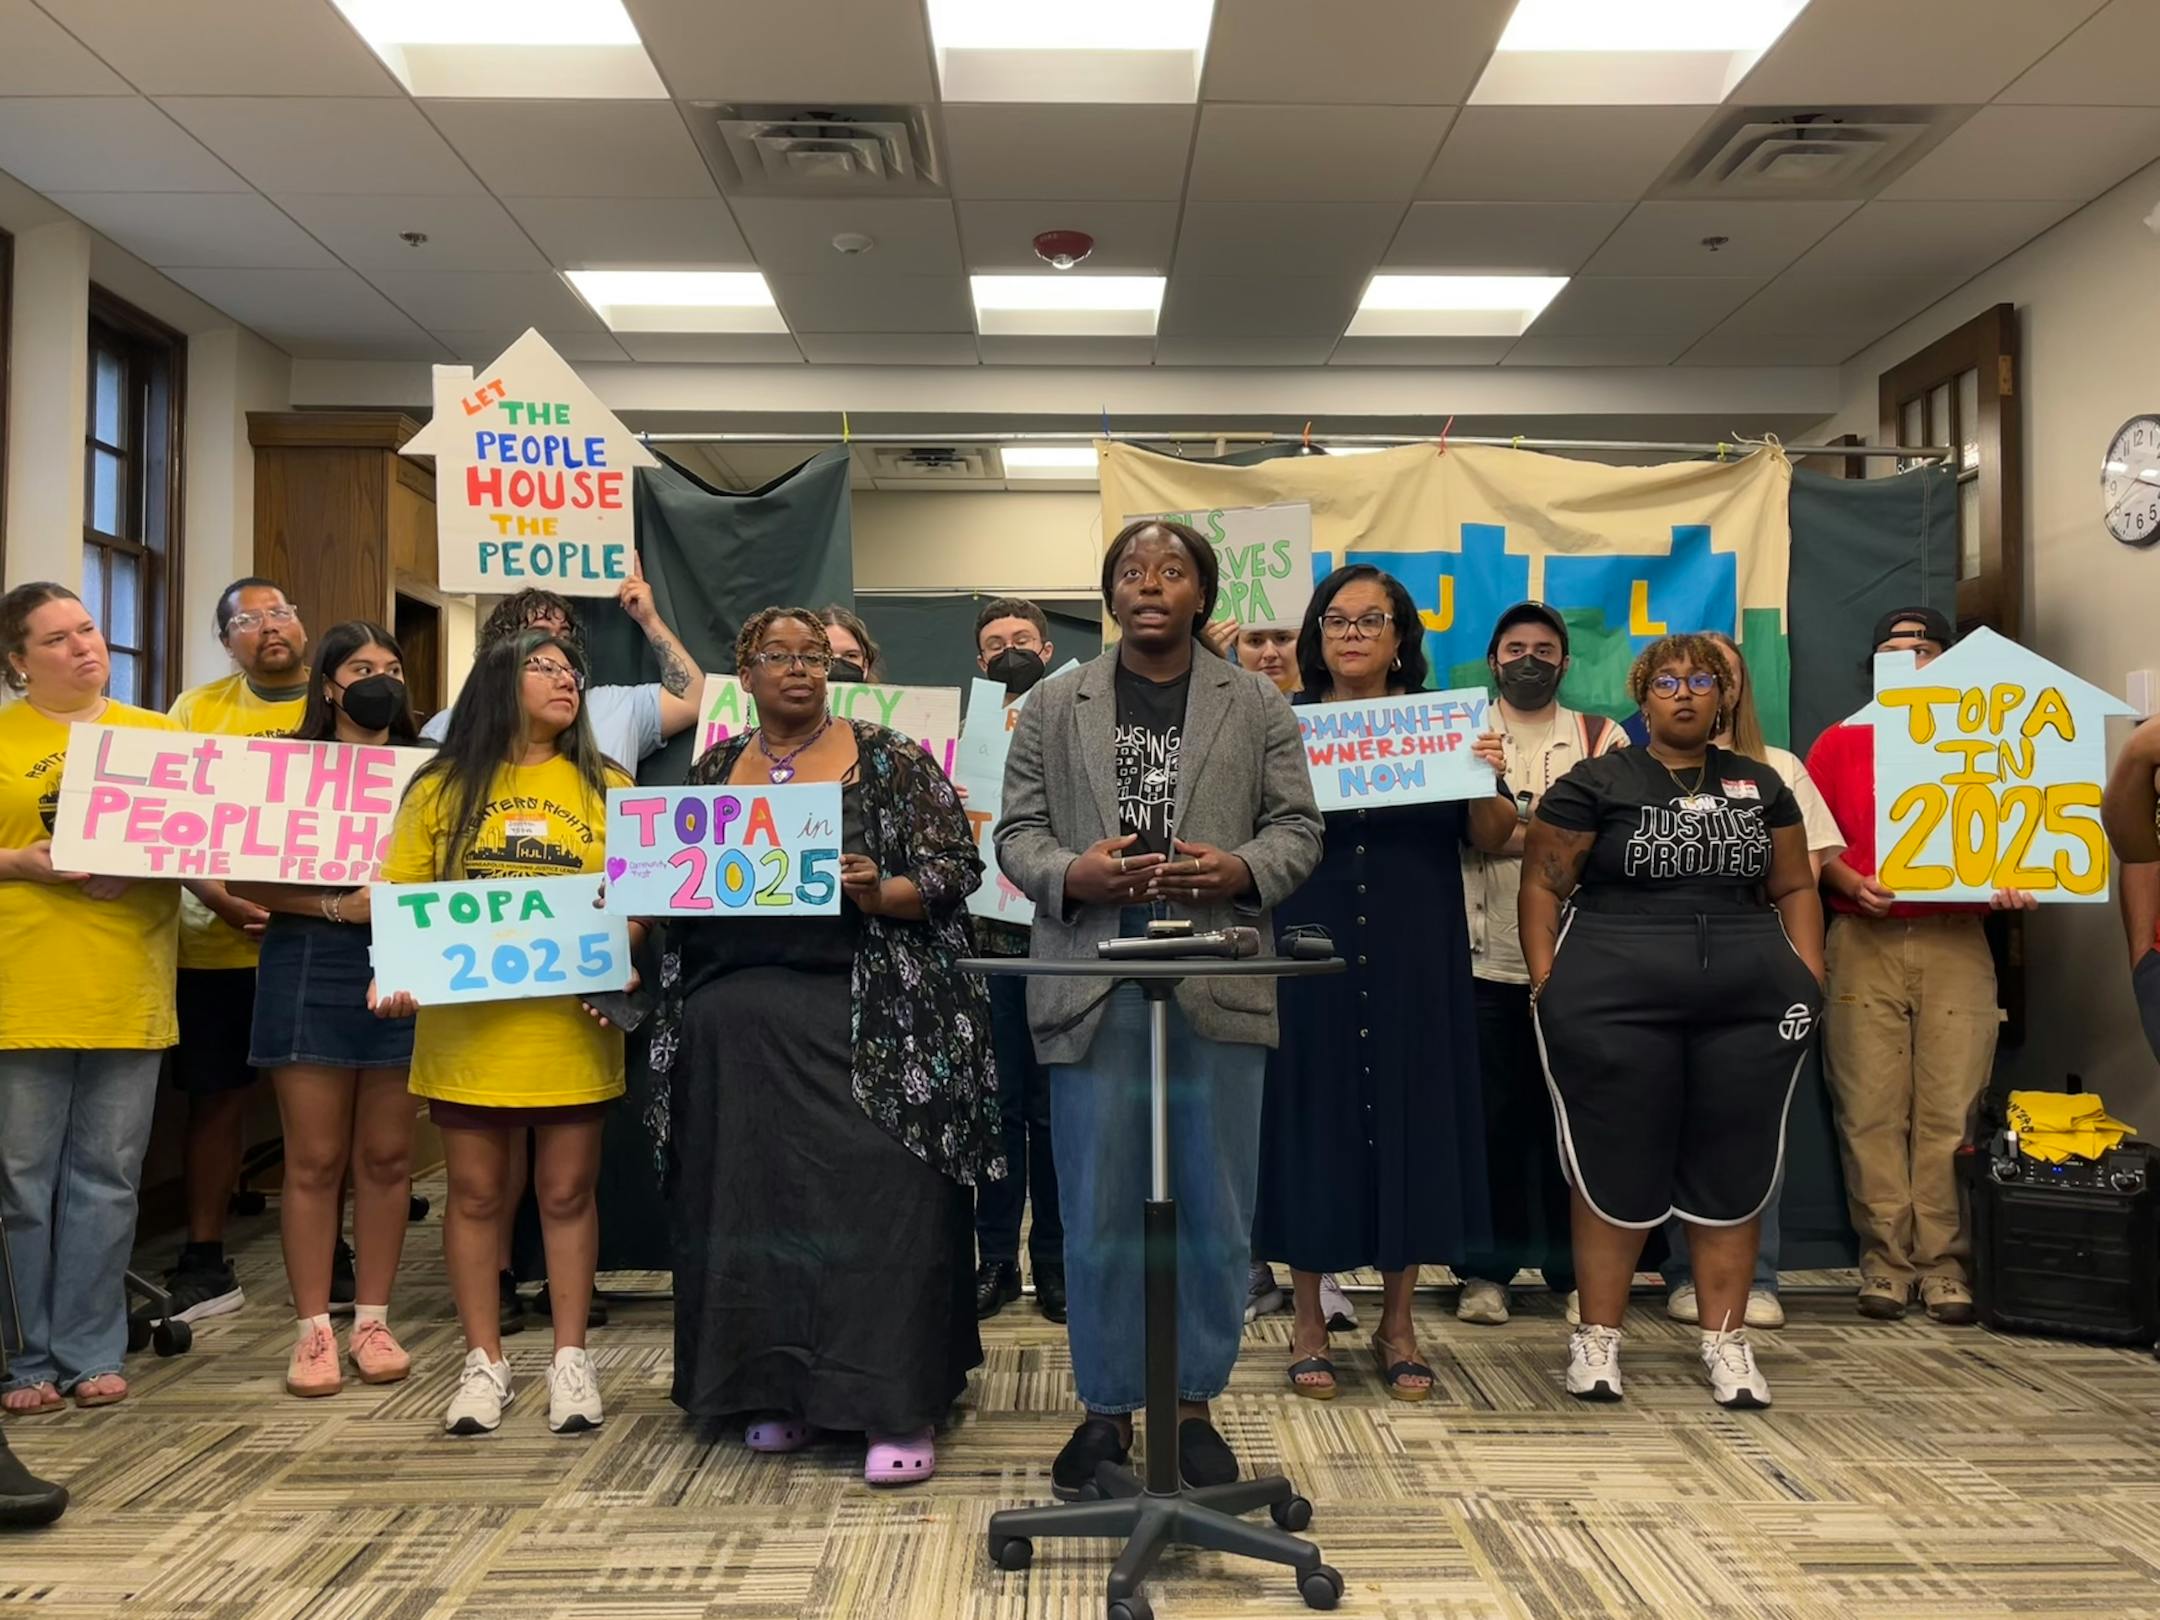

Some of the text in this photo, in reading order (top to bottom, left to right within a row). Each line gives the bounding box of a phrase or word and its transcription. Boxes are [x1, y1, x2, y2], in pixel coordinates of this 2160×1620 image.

[460, 378, 507, 417] LET
[498, 400, 571, 426] THE
[475, 430, 608, 469] PEOPLE
[2133, 429, 2144, 447] 12
[465, 465, 625, 510] HOUSE
[489, 513, 559, 537] THE
[2124, 512, 2131, 528] 7
[2136, 513, 2144, 529] 6
[2149, 504, 2157, 521] 5
[478, 541, 626, 579] PEOPLE
[1211, 578, 1276, 625] OPA
[1629, 580, 1667, 636] L
[1298, 698, 1487, 742] OMMUNITY
[1876, 682, 2076, 745] TOPA
[1307, 731, 1463, 767] WNERSHIP
[1934, 736, 2035, 784] IN
[247, 739, 397, 814] THE
[1338, 759, 1426, 798] NOW
[82, 786, 320, 857] PEOPLE
[620, 794, 833, 848] TOPA in
[1633, 804, 1770, 841] JUSTICE
[1878, 782, 2106, 895] 2025
[144, 846, 385, 882] THE PEOPL
[520, 848, 542, 858] HJL
[667, 846, 839, 909] 2025
[397, 889, 555, 929] TOPA
[441, 932, 614, 991] 2025
